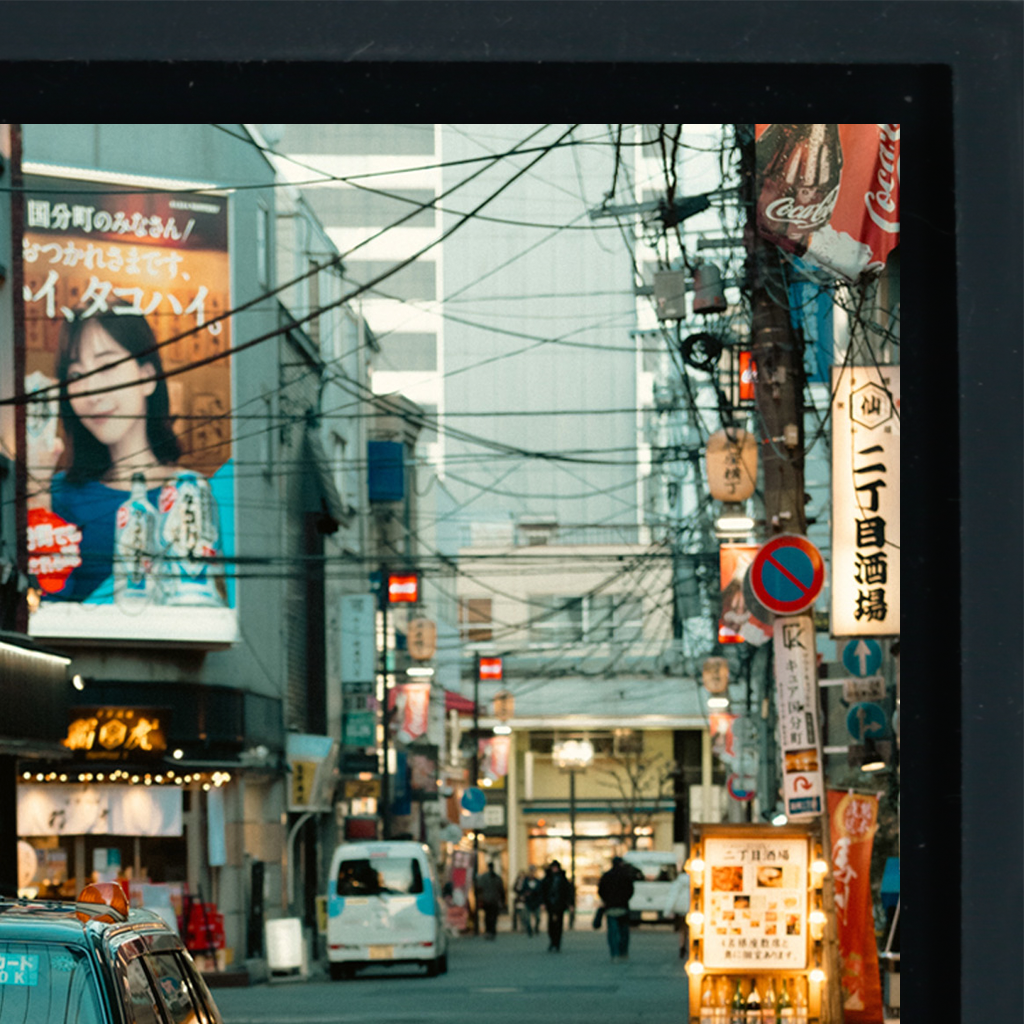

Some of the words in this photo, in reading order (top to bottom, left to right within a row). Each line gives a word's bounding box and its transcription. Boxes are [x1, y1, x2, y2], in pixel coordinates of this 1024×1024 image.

[853, 445, 888, 622] 二丁目酒場
